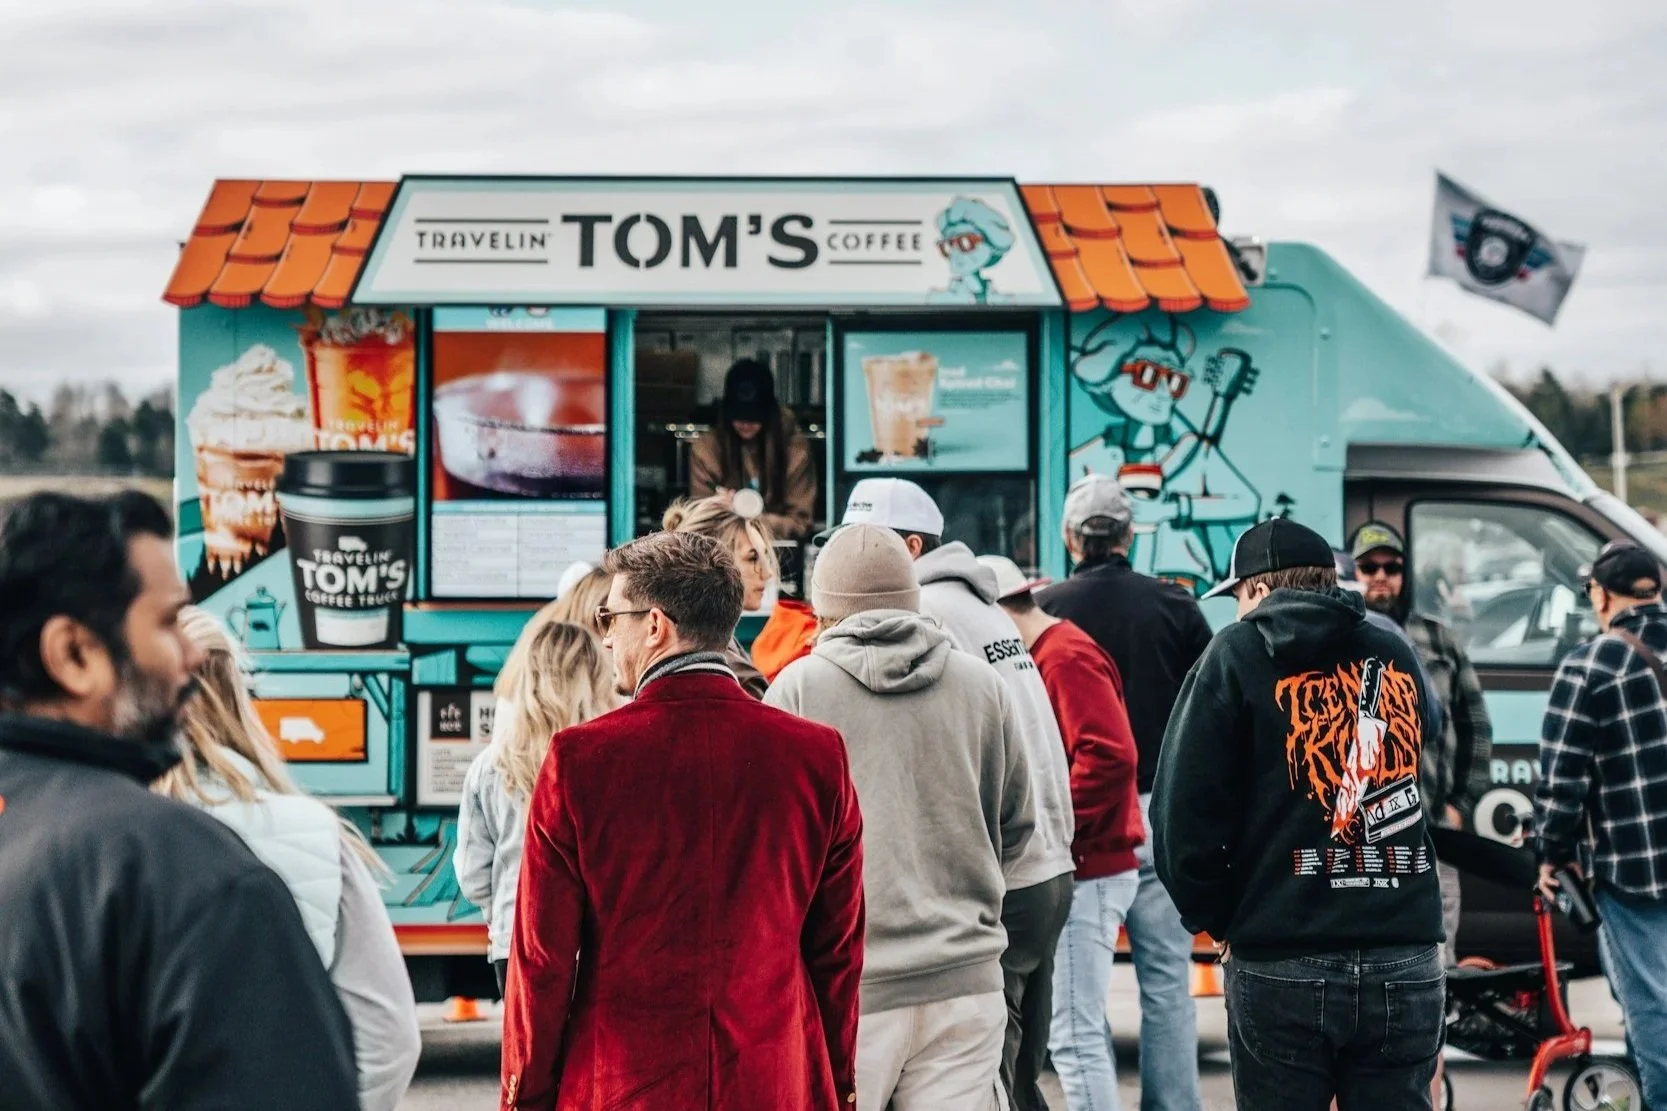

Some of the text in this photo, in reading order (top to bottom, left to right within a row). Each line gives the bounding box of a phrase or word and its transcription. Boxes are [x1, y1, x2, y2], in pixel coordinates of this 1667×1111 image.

[560, 213, 820, 269] TOM'S
[827, 232, 922, 250] COFFEE
[296, 558, 406, 595] TOM'S
[304, 589, 399, 608] COFFEE TRUCK
